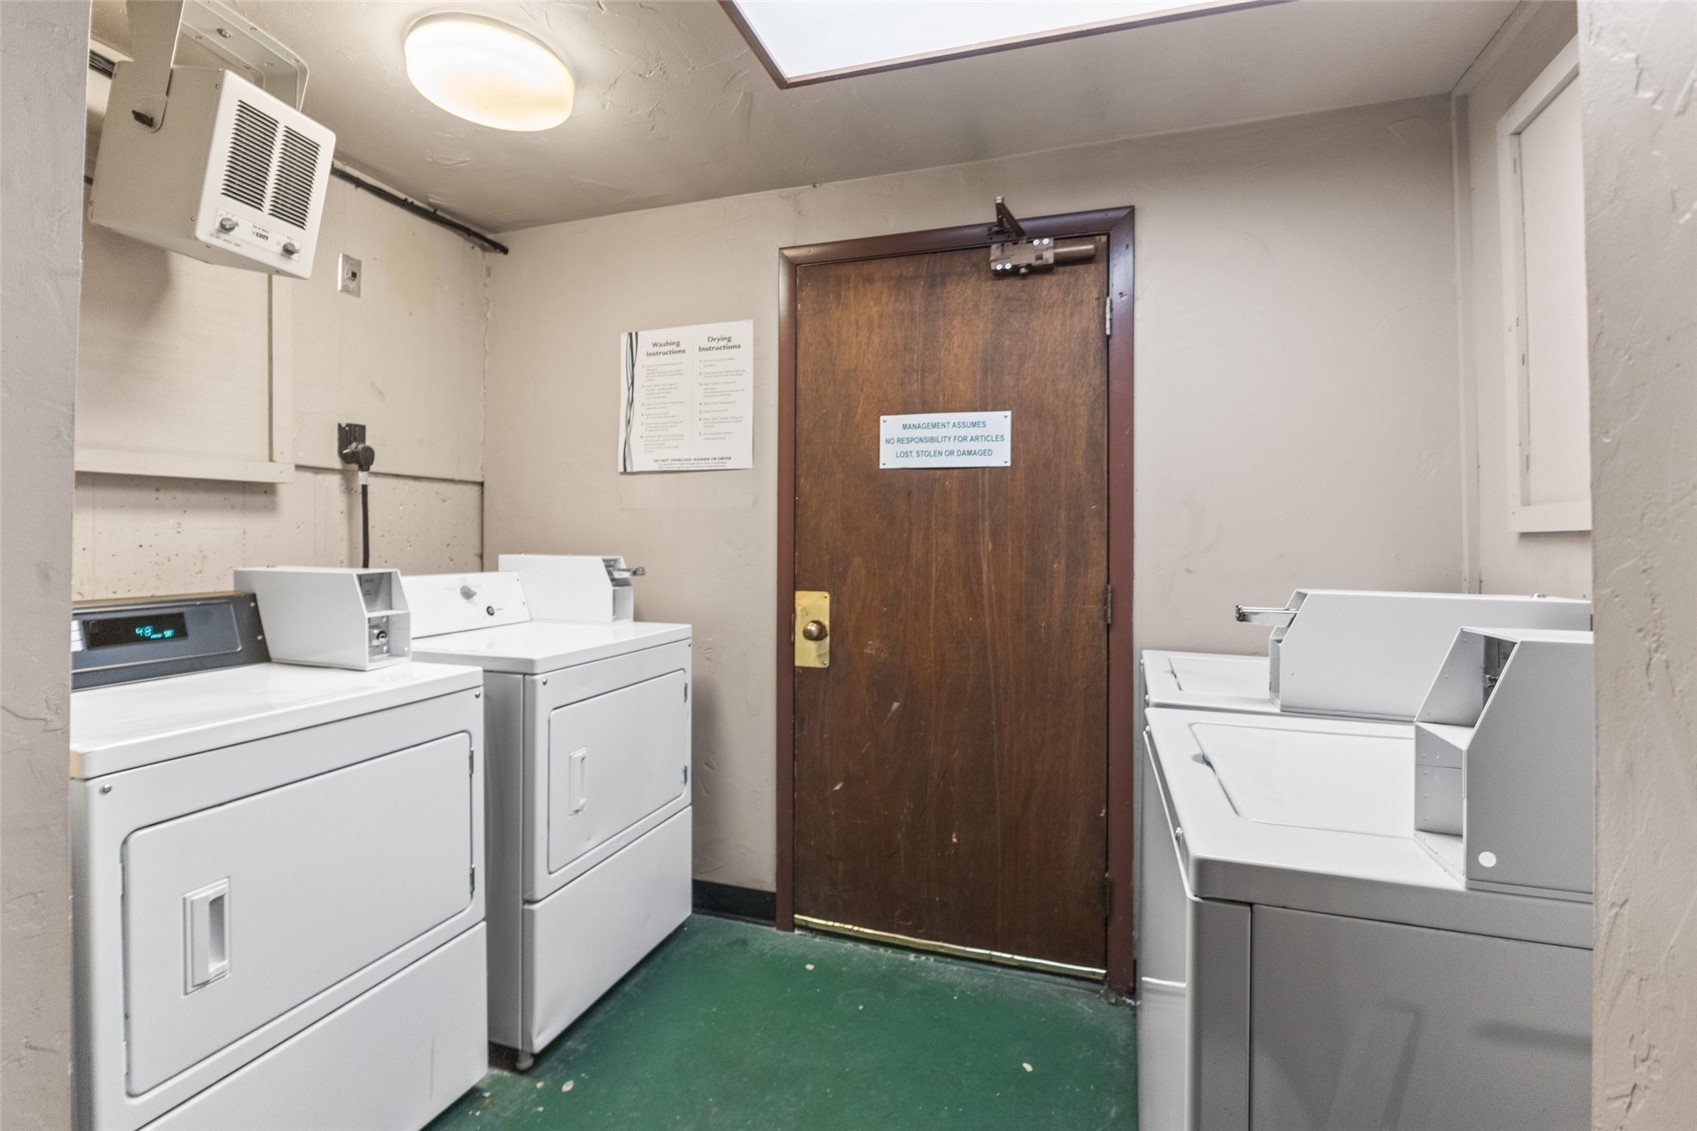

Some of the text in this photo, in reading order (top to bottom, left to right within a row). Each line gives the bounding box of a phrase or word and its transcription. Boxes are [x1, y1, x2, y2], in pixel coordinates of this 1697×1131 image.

[651, 340, 681, 348] Washing
[707, 334, 732, 344] Drying
[698, 343, 741, 352] Instructions
[646, 348, 686, 358] Instructions
[902, 420, 987, 430] MANAGEMENT ASSUMES
[885, 434, 1005, 445] NO RESPONSIBILITY FOR ARTICLES
[895, 448, 993, 459] LOST, STOLEN OR DAMAGED
[135, 625, 153, 637] 48
